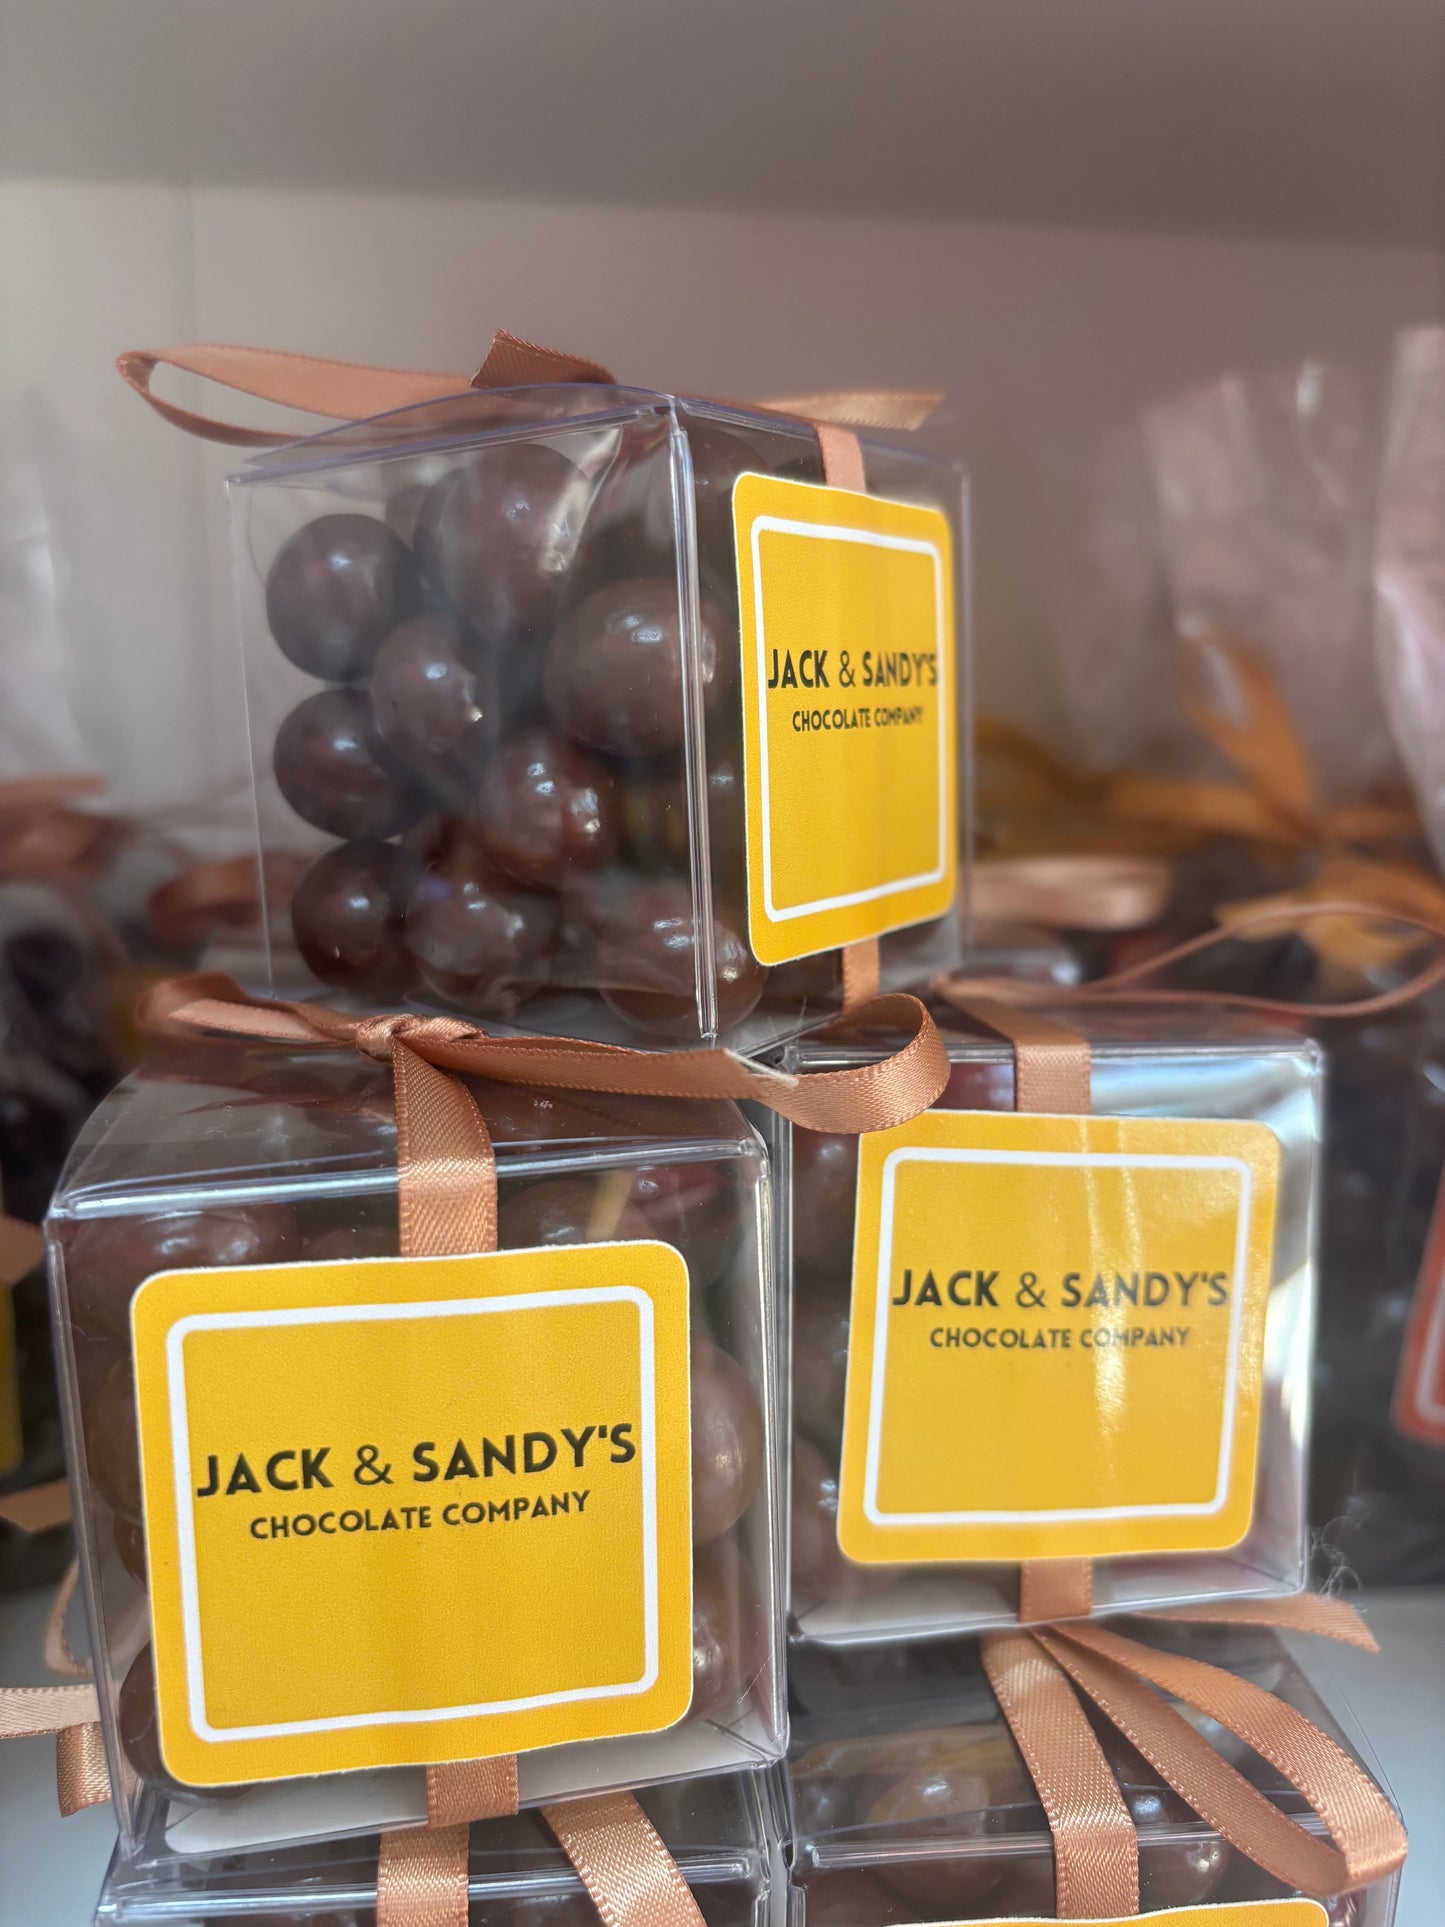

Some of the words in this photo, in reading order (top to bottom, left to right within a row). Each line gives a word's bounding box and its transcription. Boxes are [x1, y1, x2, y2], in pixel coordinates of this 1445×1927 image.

[768, 649, 830, 688] JACK
[838, 650, 856, 688] &
[862, 651, 937, 687] SANDY'S
[792, 708, 870, 732] CHOCOLATE
[874, 706, 923, 727] COMPANY
[892, 1269, 999, 1306] JACK
[1015, 1271, 1046, 1308] &
[1061, 1270, 1229, 1307] SANDY'S
[930, 1327, 1071, 1348] CHOCOLATE
[1079, 1326, 1192, 1348] COMPANY
[197, 1446, 334, 1498] JACK
[353, 1443, 394, 1486] &
[412, 1422, 636, 1482] SANDY'S
[250, 1505, 431, 1540] CHOCOLATE
[442, 1489, 591, 1526] COMPANY
